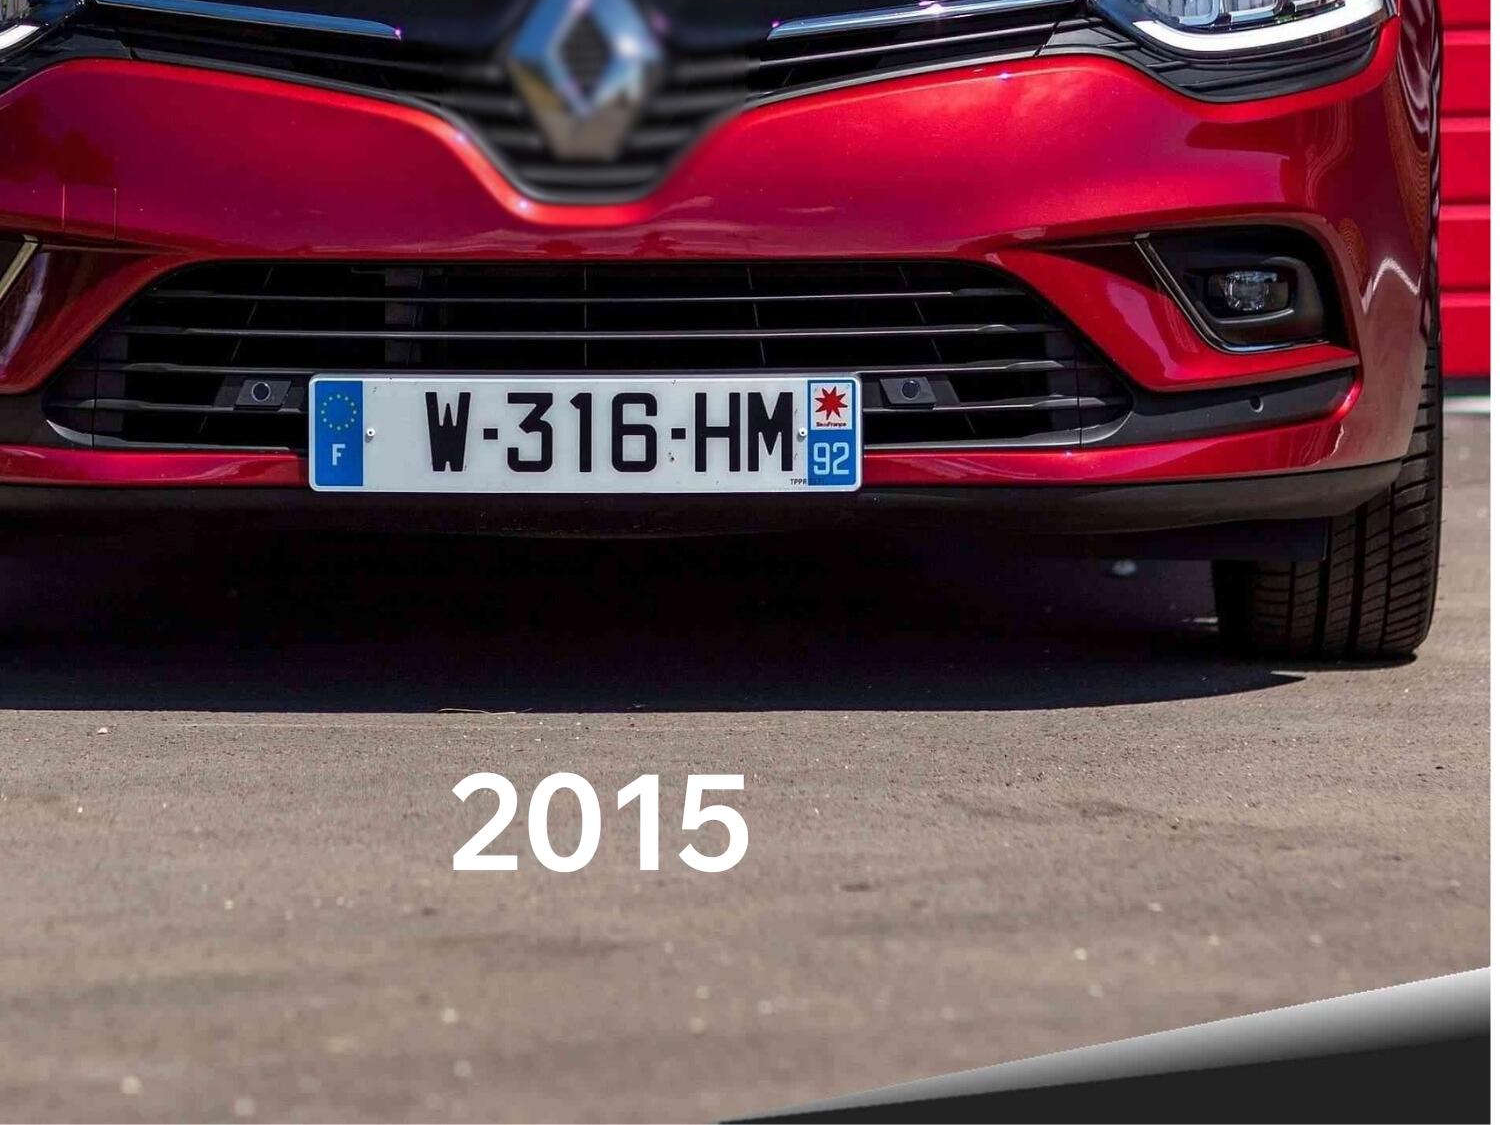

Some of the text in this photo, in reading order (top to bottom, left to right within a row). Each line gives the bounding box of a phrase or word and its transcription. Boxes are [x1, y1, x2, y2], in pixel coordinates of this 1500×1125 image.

[425, 391, 794, 473] W-316-HM
[332, 443, 346, 466] F
[813, 442, 850, 475] 92
